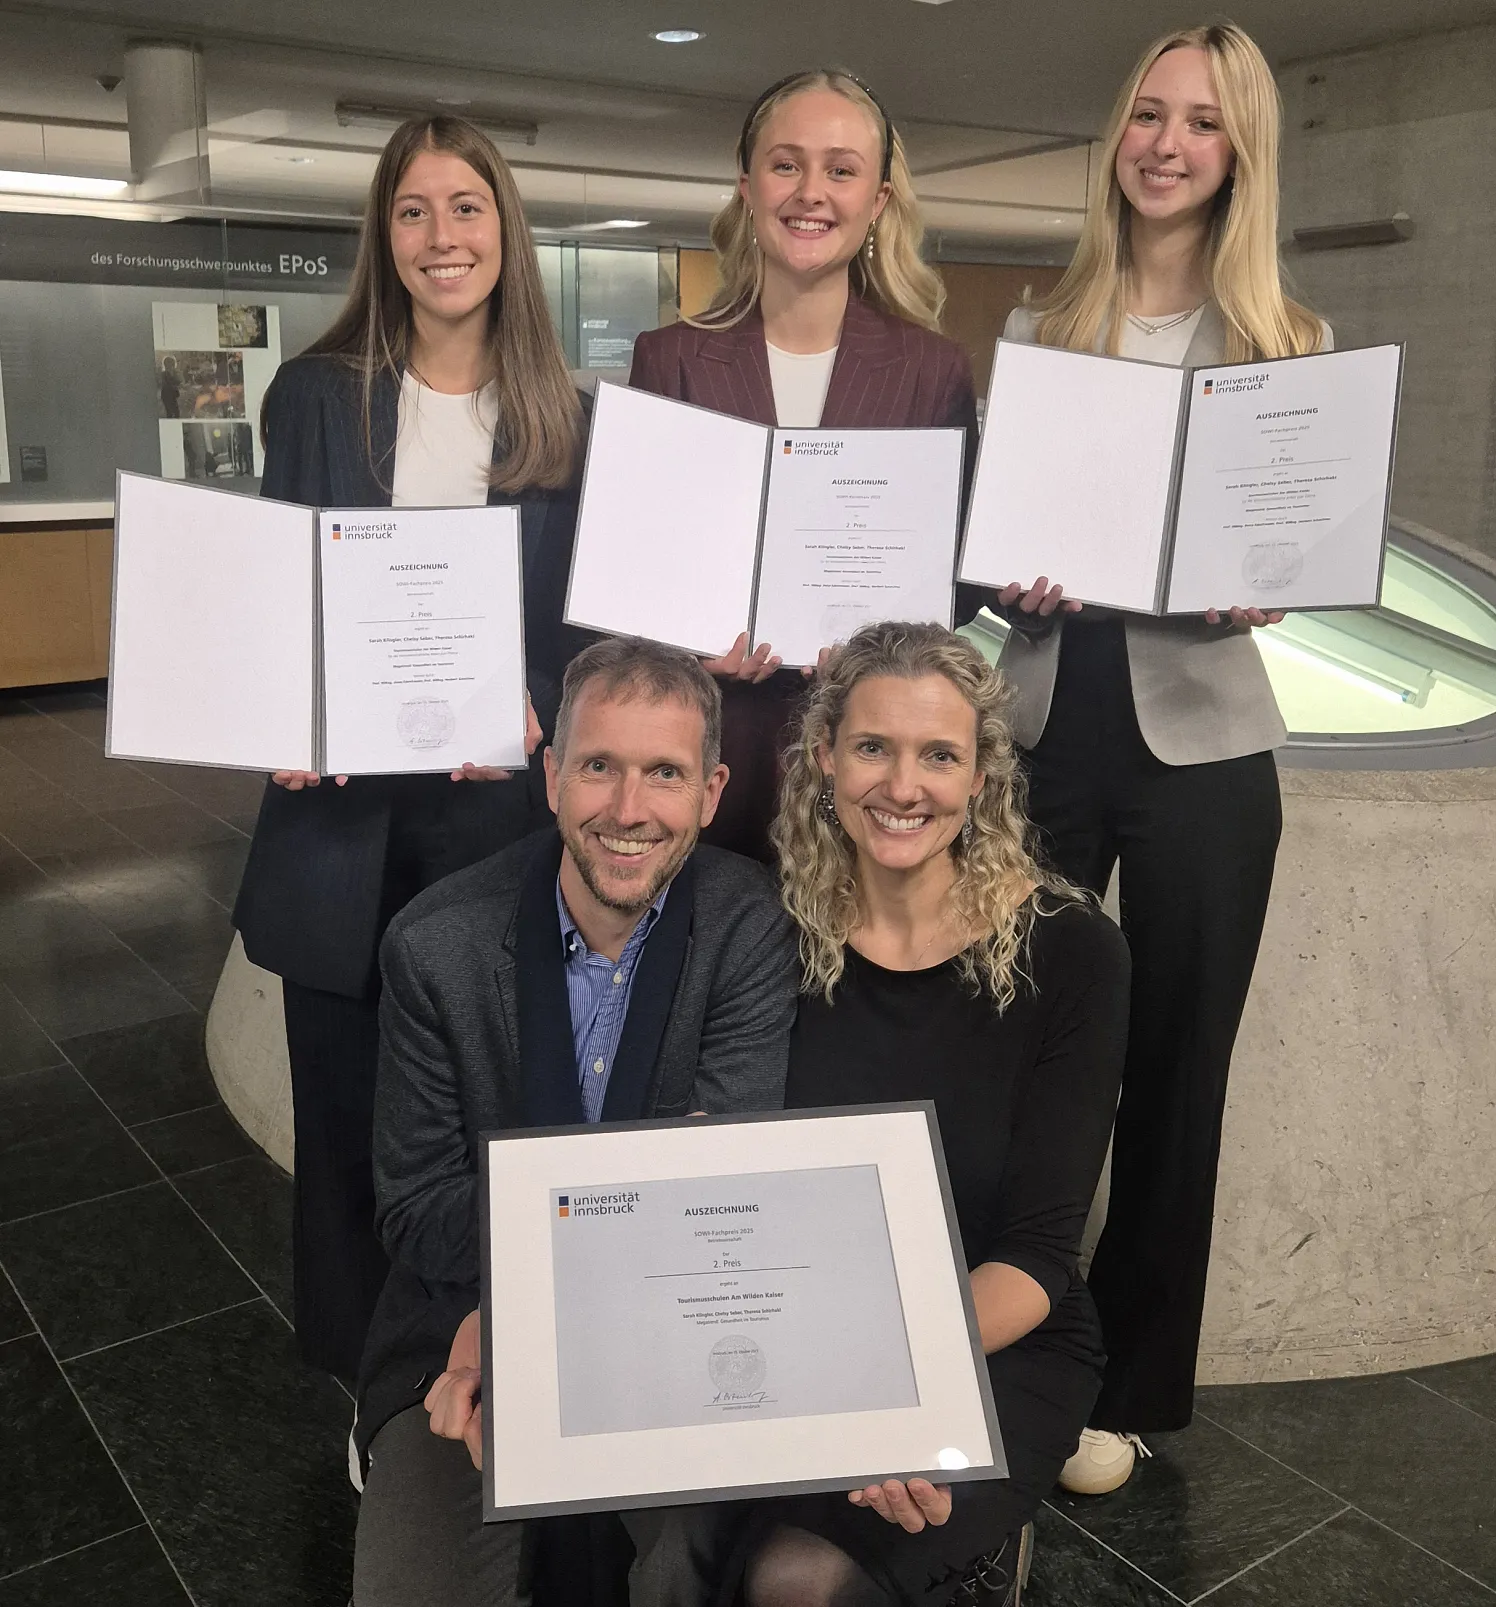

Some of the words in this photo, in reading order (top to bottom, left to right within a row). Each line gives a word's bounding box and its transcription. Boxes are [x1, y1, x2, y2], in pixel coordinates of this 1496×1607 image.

[91, 252, 112, 265] des
[116, 253, 272, 273] Forschungsschwerpunktes
[279, 254, 328, 275] EPoS
[1216, 373, 1270, 387] universität
[1215, 382, 1264, 394] innsbruck
[1256, 407, 1319, 420] AUSZEICHNUNG
[795, 440, 844, 449] universität
[794, 448, 839, 456] innsbruck
[345, 523, 397, 532] universität
[345, 531, 392, 540] innsbruck
[389, 562, 449, 571] AUSZEICHNUNG
[574, 1191, 640, 1206] universität
[574, 1203, 634, 1217] innsbruck
[684, 1204, 759, 1217] AUSZEICHNUNG
[694, 1229, 739, 1237] SOWI-Fachpreis
[713, 1260, 721, 1268] 2.
[723, 1259, 742, 1268] Preis
[677, 1295, 729, 1304] Tourismusschulen
[742, 1292, 764, 1300] Wilden
